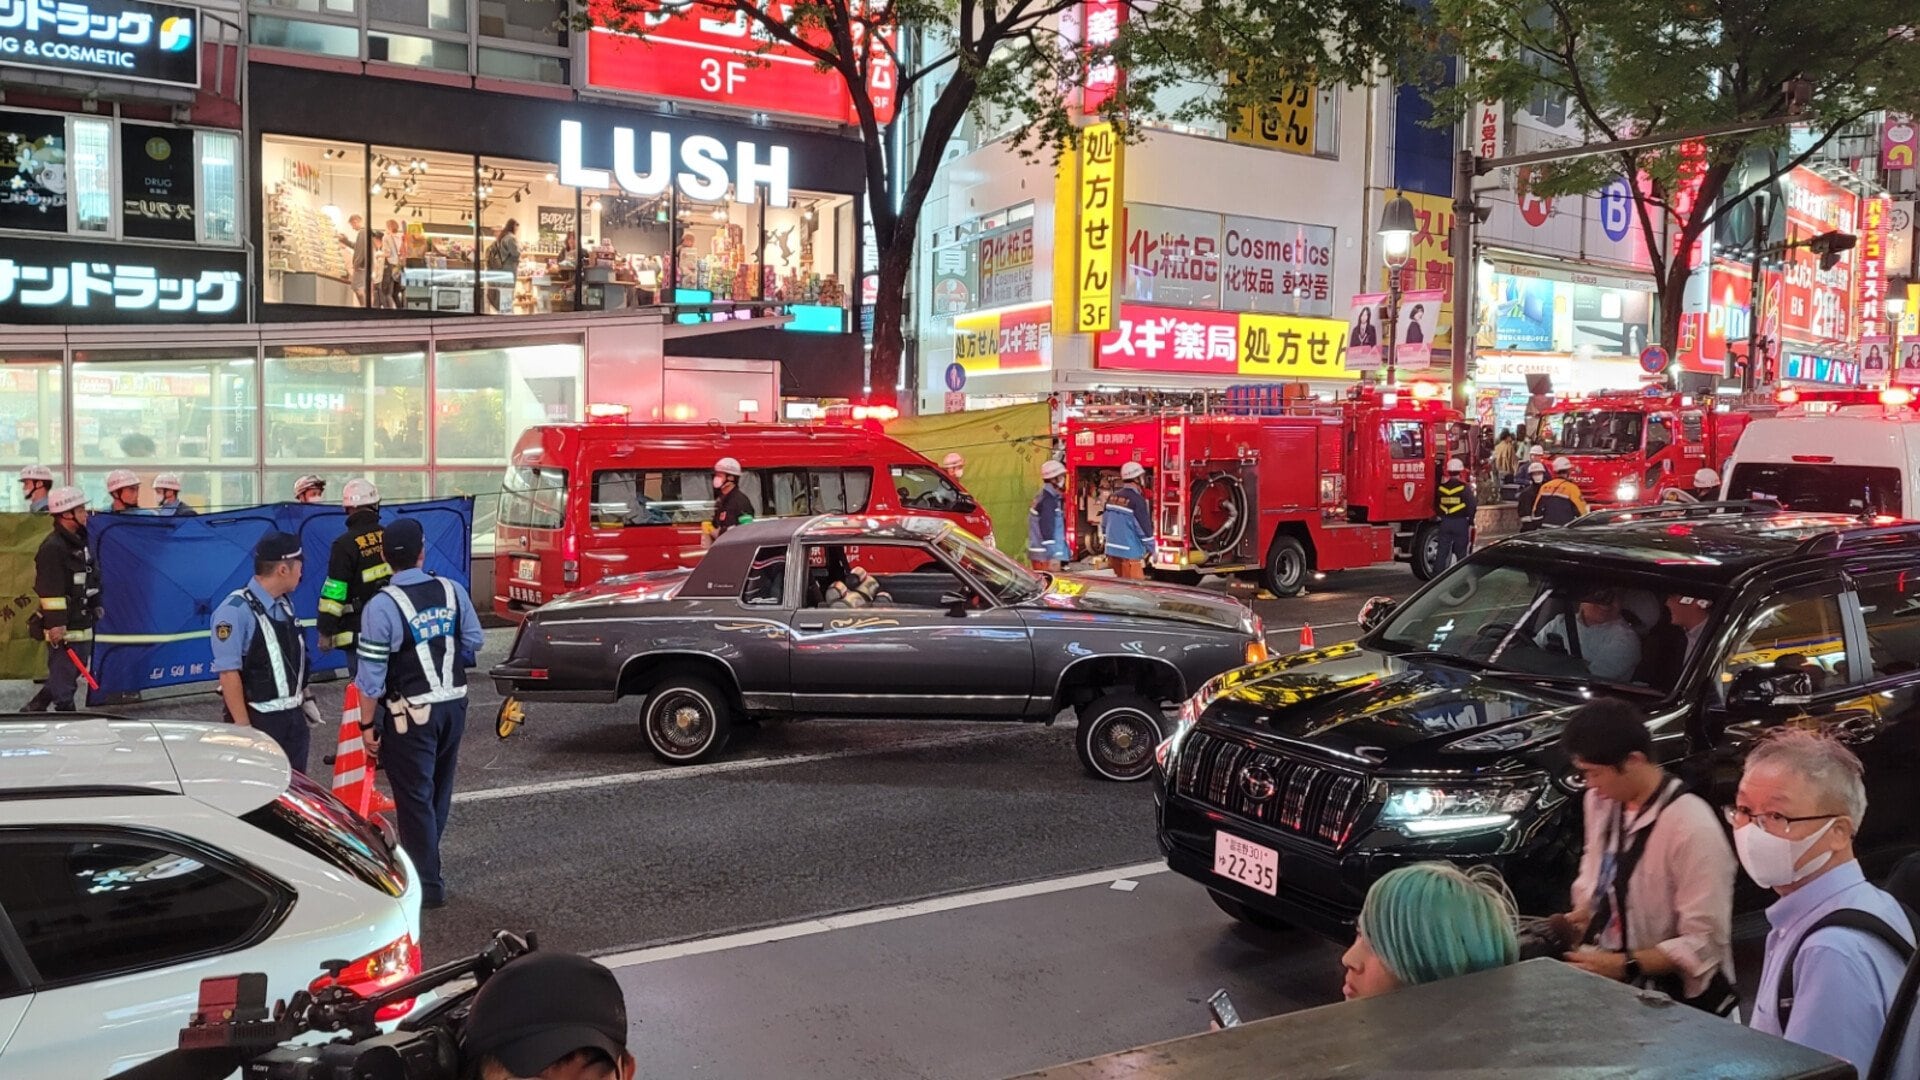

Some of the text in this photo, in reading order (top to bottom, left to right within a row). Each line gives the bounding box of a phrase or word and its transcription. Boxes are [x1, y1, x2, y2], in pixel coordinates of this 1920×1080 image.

[0, 36, 136, 68] G & COSMETIC
[700, 58, 747, 94] 3F
[873, 96, 889, 107] 3F
[560, 119, 790, 207] LUSH
[144, 178, 173, 188] DRUG
[1085, 131, 1112, 291] 処方せん
[1607, 181, 1627, 233] B
[1129, 228, 1217, 282] 化粧品
[1225, 229, 1330, 267] Cosmetics
[1082, 303, 1107, 326] 3F
[1862, 260, 1880, 337] エスパス
[955, 330, 998, 359] 処方せん
[1102, 316, 1236, 362] スギ薬局
[284, 392, 345, 410] LUSH
[411, 608, 455, 629] POLICE
